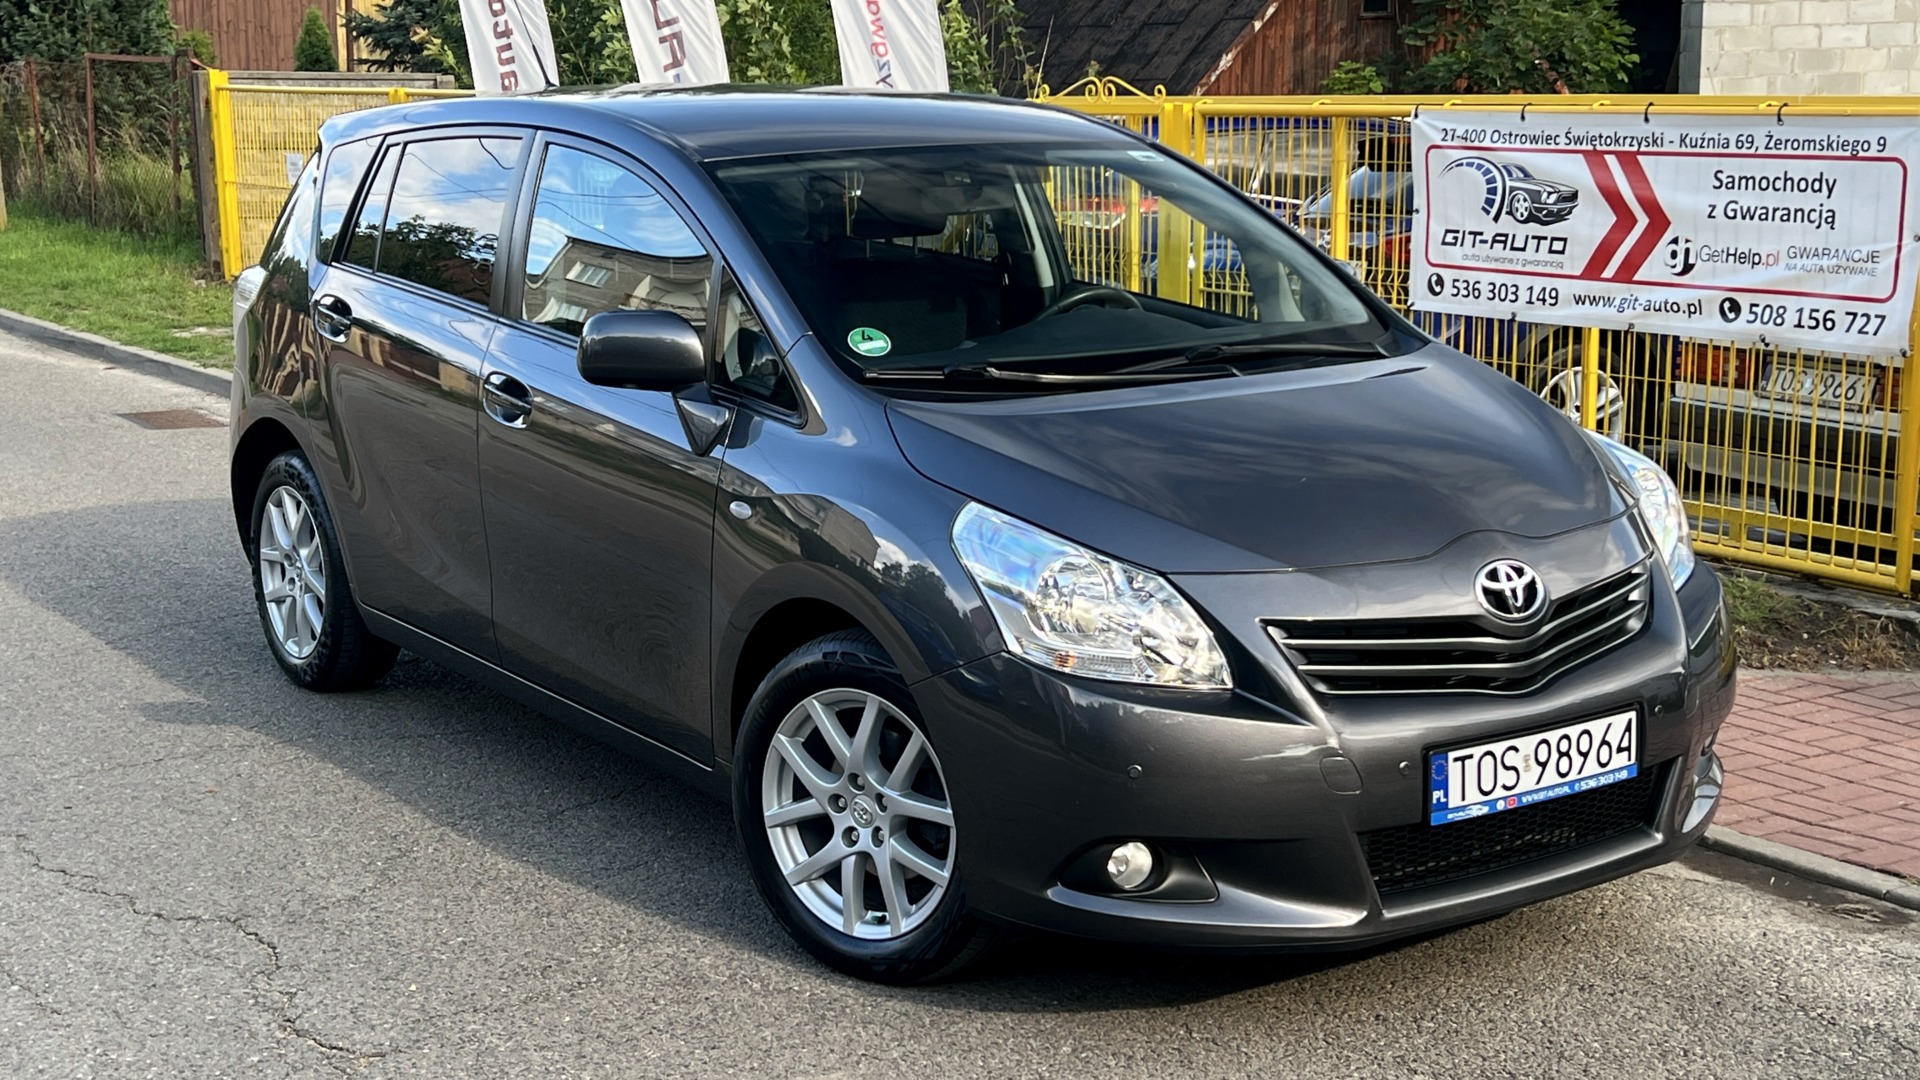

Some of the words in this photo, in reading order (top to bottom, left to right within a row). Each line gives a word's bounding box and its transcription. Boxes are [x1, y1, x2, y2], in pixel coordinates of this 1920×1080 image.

[1440, 128, 1487, 144] 27-400
[1490, 129, 1560, 146] Ostrowiec
[1564, 127, 1664, 151] Świętokrzyski
[1679, 132, 1730, 150] Kuźnia
[1734, 133, 1760, 153] 69,
[1764, 131, 1871, 156] Żeromskiego
[1876, 136, 1888, 153] 9
[1712, 170, 1837, 199] Samochody
[1707, 203, 1717, 219] z
[1723, 200, 1837, 230] Gwarancją
[1441, 228, 1569, 255] GIT-AUTO
[1787, 245, 1880, 264] GWARANCJE
[1462, 253, 1480, 262] auta
[1700, 245, 1780, 269] GetHelp.pl
[1784, 262, 1797, 272] NA
[1798, 263, 1825, 274] AUTA
[1450, 278, 1482, 299] 536
[1486, 282, 1520, 303] 303
[1525, 286, 1559, 306] 149
[1573, 293, 1703, 319] www.git-auto.pl
[1746, 303, 1788, 327] 508
[1793, 307, 1837, 332] 156
[1844, 311, 1887, 337] 727
[1453, 745, 1521, 802] TOS
[1534, 718, 1633, 786] 98964
[1432, 789, 1447, 804] PL
